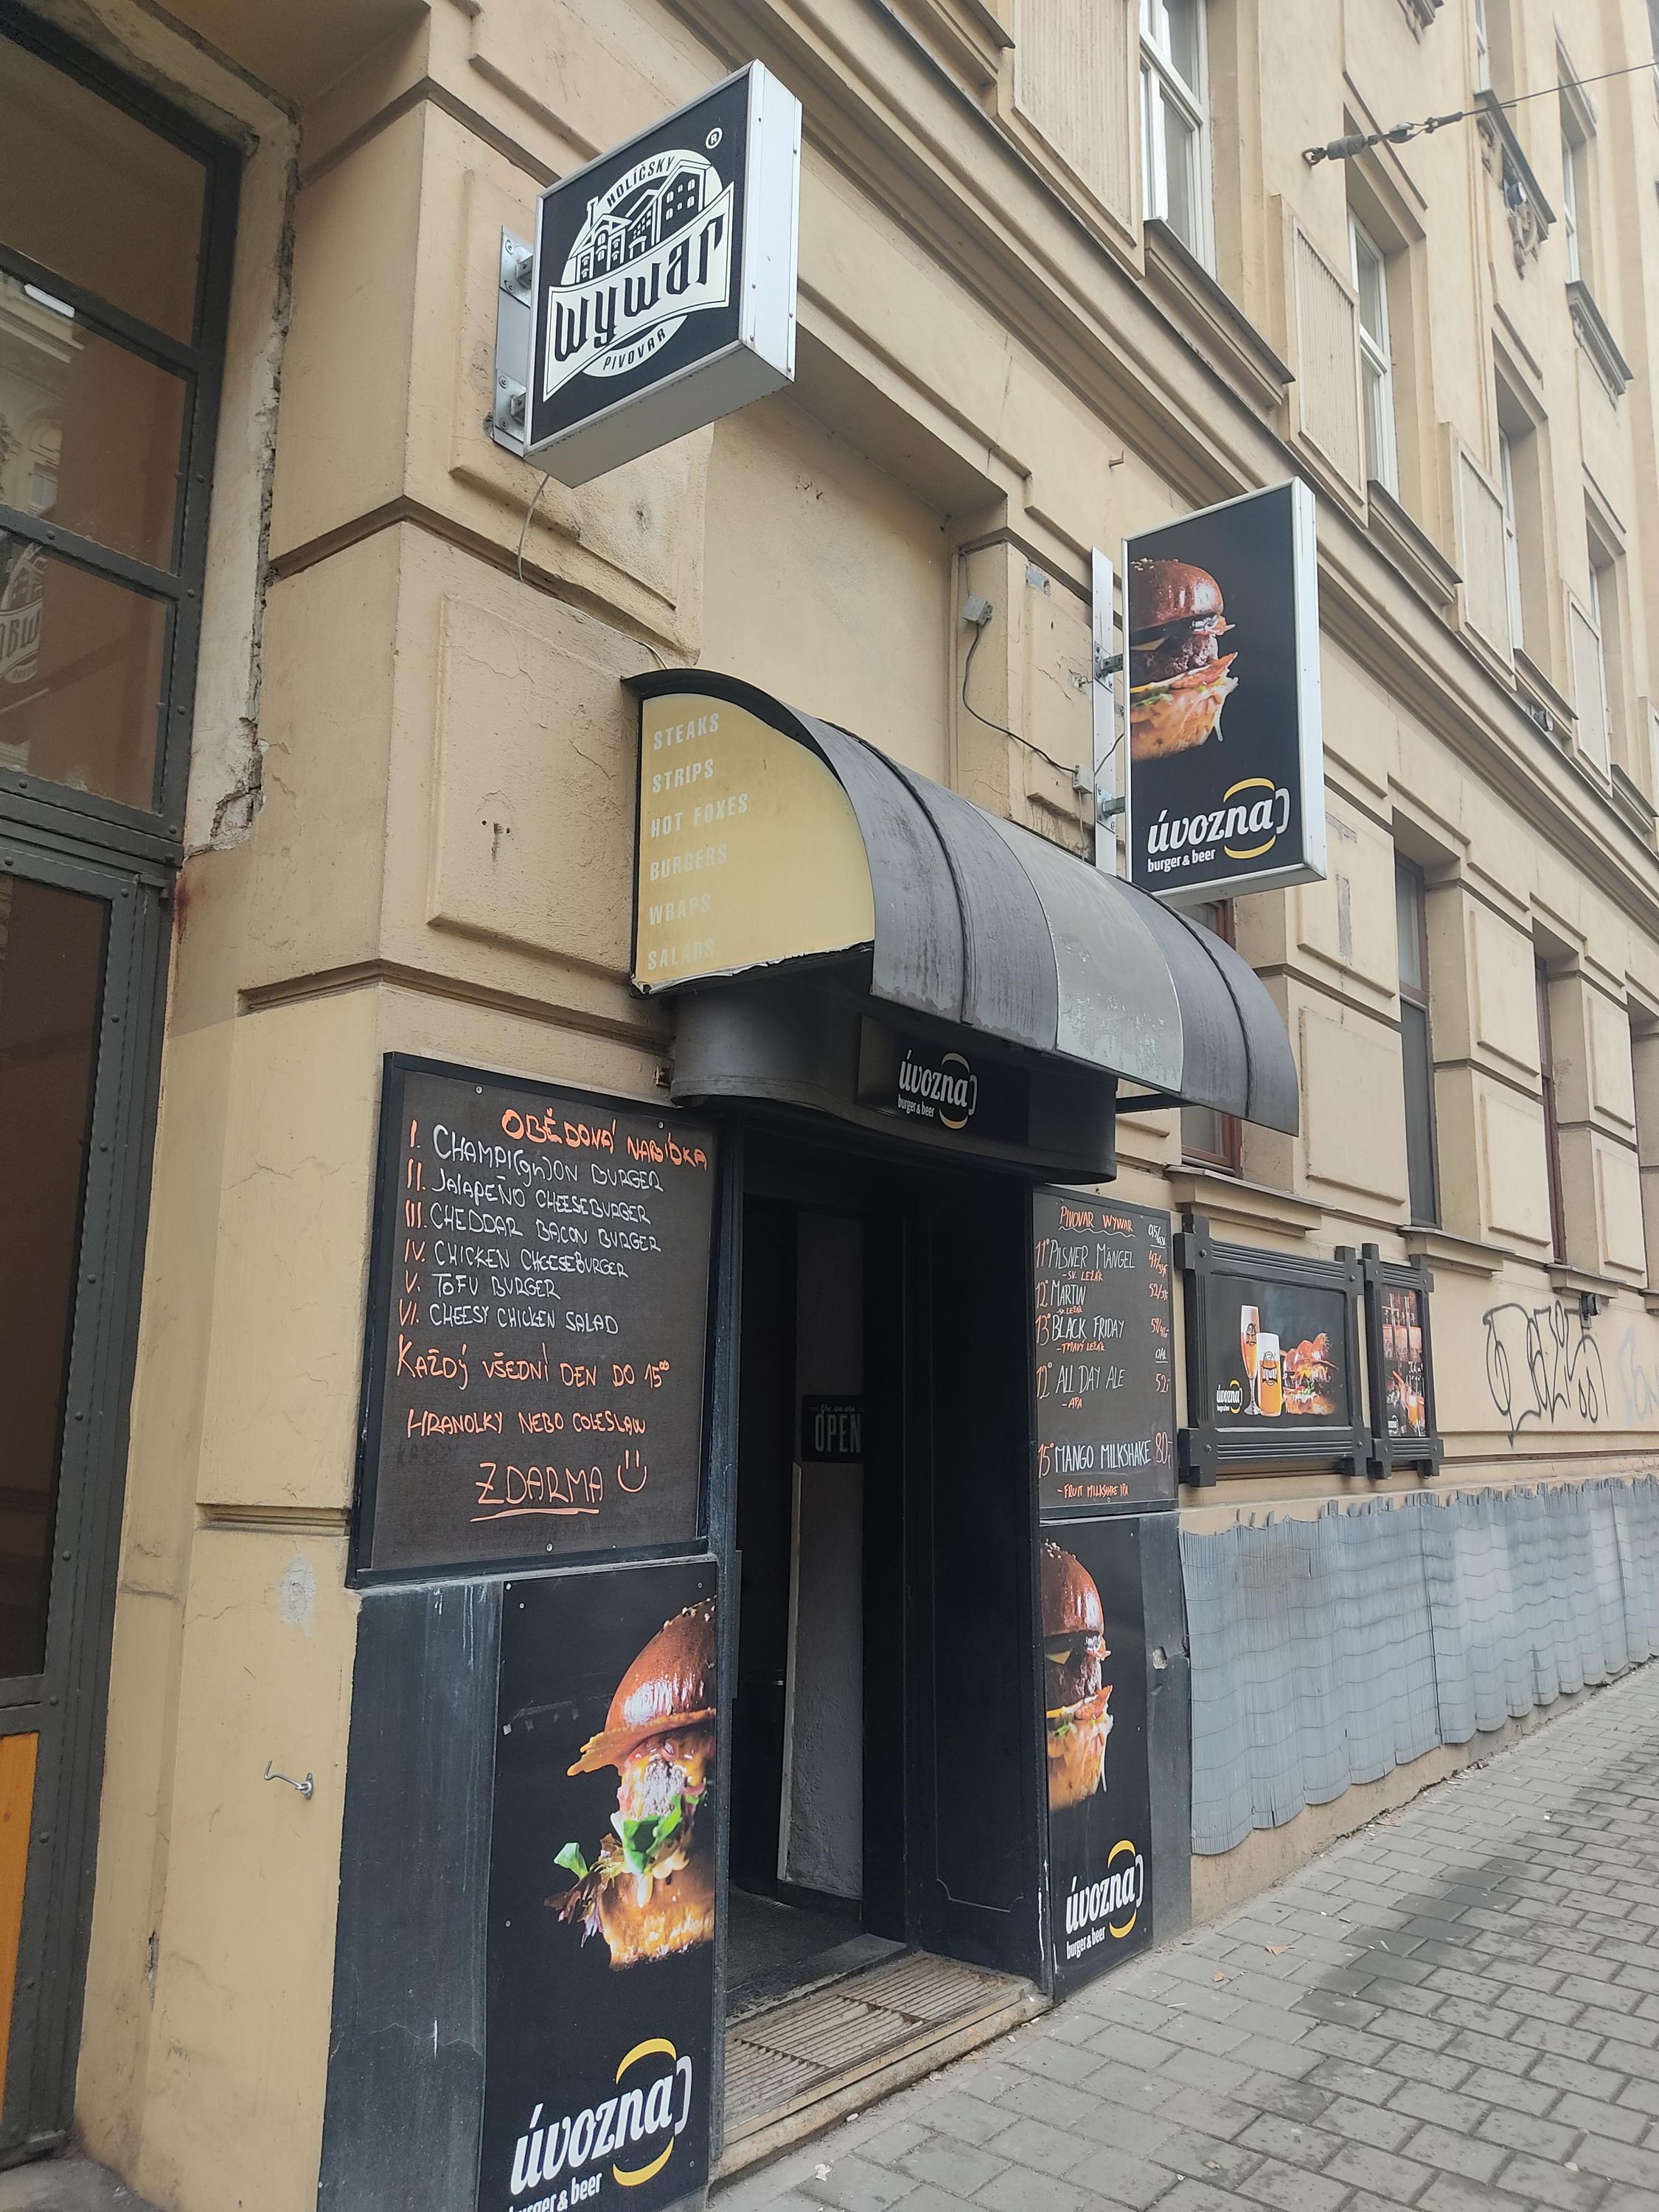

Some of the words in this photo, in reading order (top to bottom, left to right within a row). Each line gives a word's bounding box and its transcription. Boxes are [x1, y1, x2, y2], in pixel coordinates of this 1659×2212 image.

[607, 156, 675, 208] HOLÍČSKY
[555, 213, 727, 362] wywar
[604, 329, 666, 371] PIVOVAR
[653, 713, 719, 750] STEAKS
[653, 759, 714, 793] STRIPS
[651, 812, 683, 838] HOT
[694, 793, 748, 826] FOXES
[1147, 799, 1274, 854] úvozna
[650, 844, 727, 880] BURGERS
[1148, 857, 1181, 872] burger
[1182, 855, 1190, 865] &
[1192, 849, 1216, 864] beer
[649, 894, 709, 925] WRAPS
[899, 1050, 967, 1107] úvozna
[897, 1093, 916, 1114] burger
[922, 1102, 935, 1118] beer
[407, 1158, 426, 1192] II.
[591, 1164, 663, 1192] BURGER
[405, 1200, 428, 1229] III.
[430, 1203, 523, 1237] CHEDDAR
[536, 1219, 588, 1245] BACON
[598, 1228, 661, 1253] BURGER
[1060, 1206, 1094, 1228] PIVOVAR
[1102, 1214, 1133, 1232] WYWAR
[405, 1239, 426, 1263] IV.
[434, 1240, 510, 1270] CHICKEN
[521, 1249, 629, 1279] CHEESEBURGER
[1048, 1239, 1088, 1269] PILSNER
[405, 1270, 421, 1293] V.
[492, 1276, 560, 1300] BURGER
[1051, 1279, 1086, 1307] MARTIN
[398, 1298, 420, 1326] VI.
[429, 1304, 490, 1326] CHEESY
[498, 1307, 556, 1329] CHICKEN
[566, 1312, 619, 1335] SALAD
[1052, 1314, 1088, 1341] BLACK
[1093, 1315, 1124, 1340] FRIDAY
[560, 1363, 597, 1388] DEN
[612, 1363, 635, 1388] DO
[1055, 1365, 1074, 1394] ALL
[1078, 1365, 1101, 1394] DAY
[1105, 1366, 1126, 1390] ALE
[407, 1409, 503, 1438] HRANOLKY
[518, 1411, 564, 1434] NEBO
[815, 1414, 861, 1453] OPEN
[1054, 1444, 1093, 1473] MANGO
[1100, 1440, 1152, 1470] MILKSHAKE
[475, 1461, 604, 1505] ZDARMA
[1087, 1484, 1119, 1498] MILKSHAKE
[1120, 1483, 1128, 1498] IPA
[1066, 1866, 1135, 1934] úvozna
[1067, 1941, 1086, 1959] burger
[1092, 1927, 1105, 1945] beer
[510, 2075, 673, 2194] úvozna
[557, 2190, 568, 2212] &
[571, 2173, 602, 2205] beer
